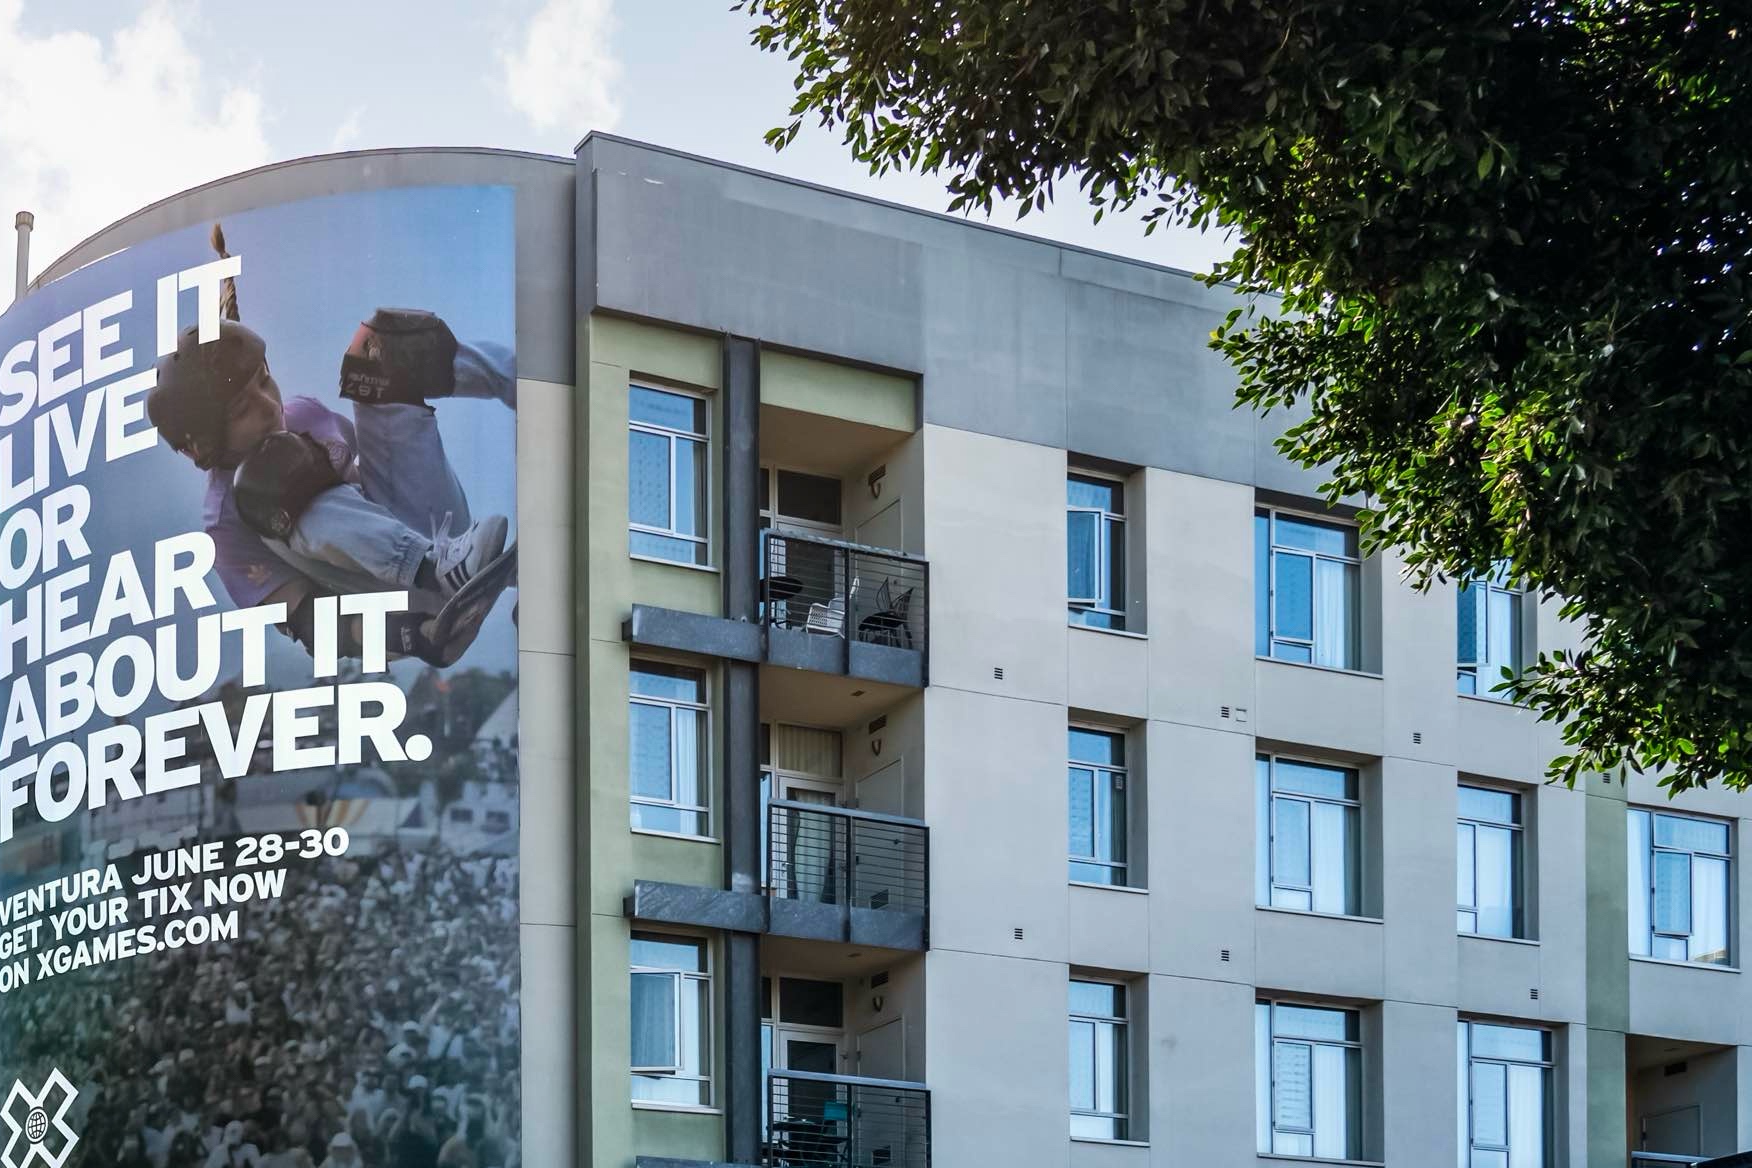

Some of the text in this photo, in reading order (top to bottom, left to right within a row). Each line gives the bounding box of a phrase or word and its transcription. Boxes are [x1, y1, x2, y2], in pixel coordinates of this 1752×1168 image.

[156, 255, 242, 361] IT
[312, 590, 409, 678] IT
[0, 683, 434, 844] FOREVER.
[131, 841, 224, 885] JUNE
[235, 826, 350, 868] 28-30
[50, 896, 128, 941] YOUR
[137, 882, 193, 919] TIX
[204, 868, 287, 907] NOW
[36, 910, 239, 981] XGAMES.COM
